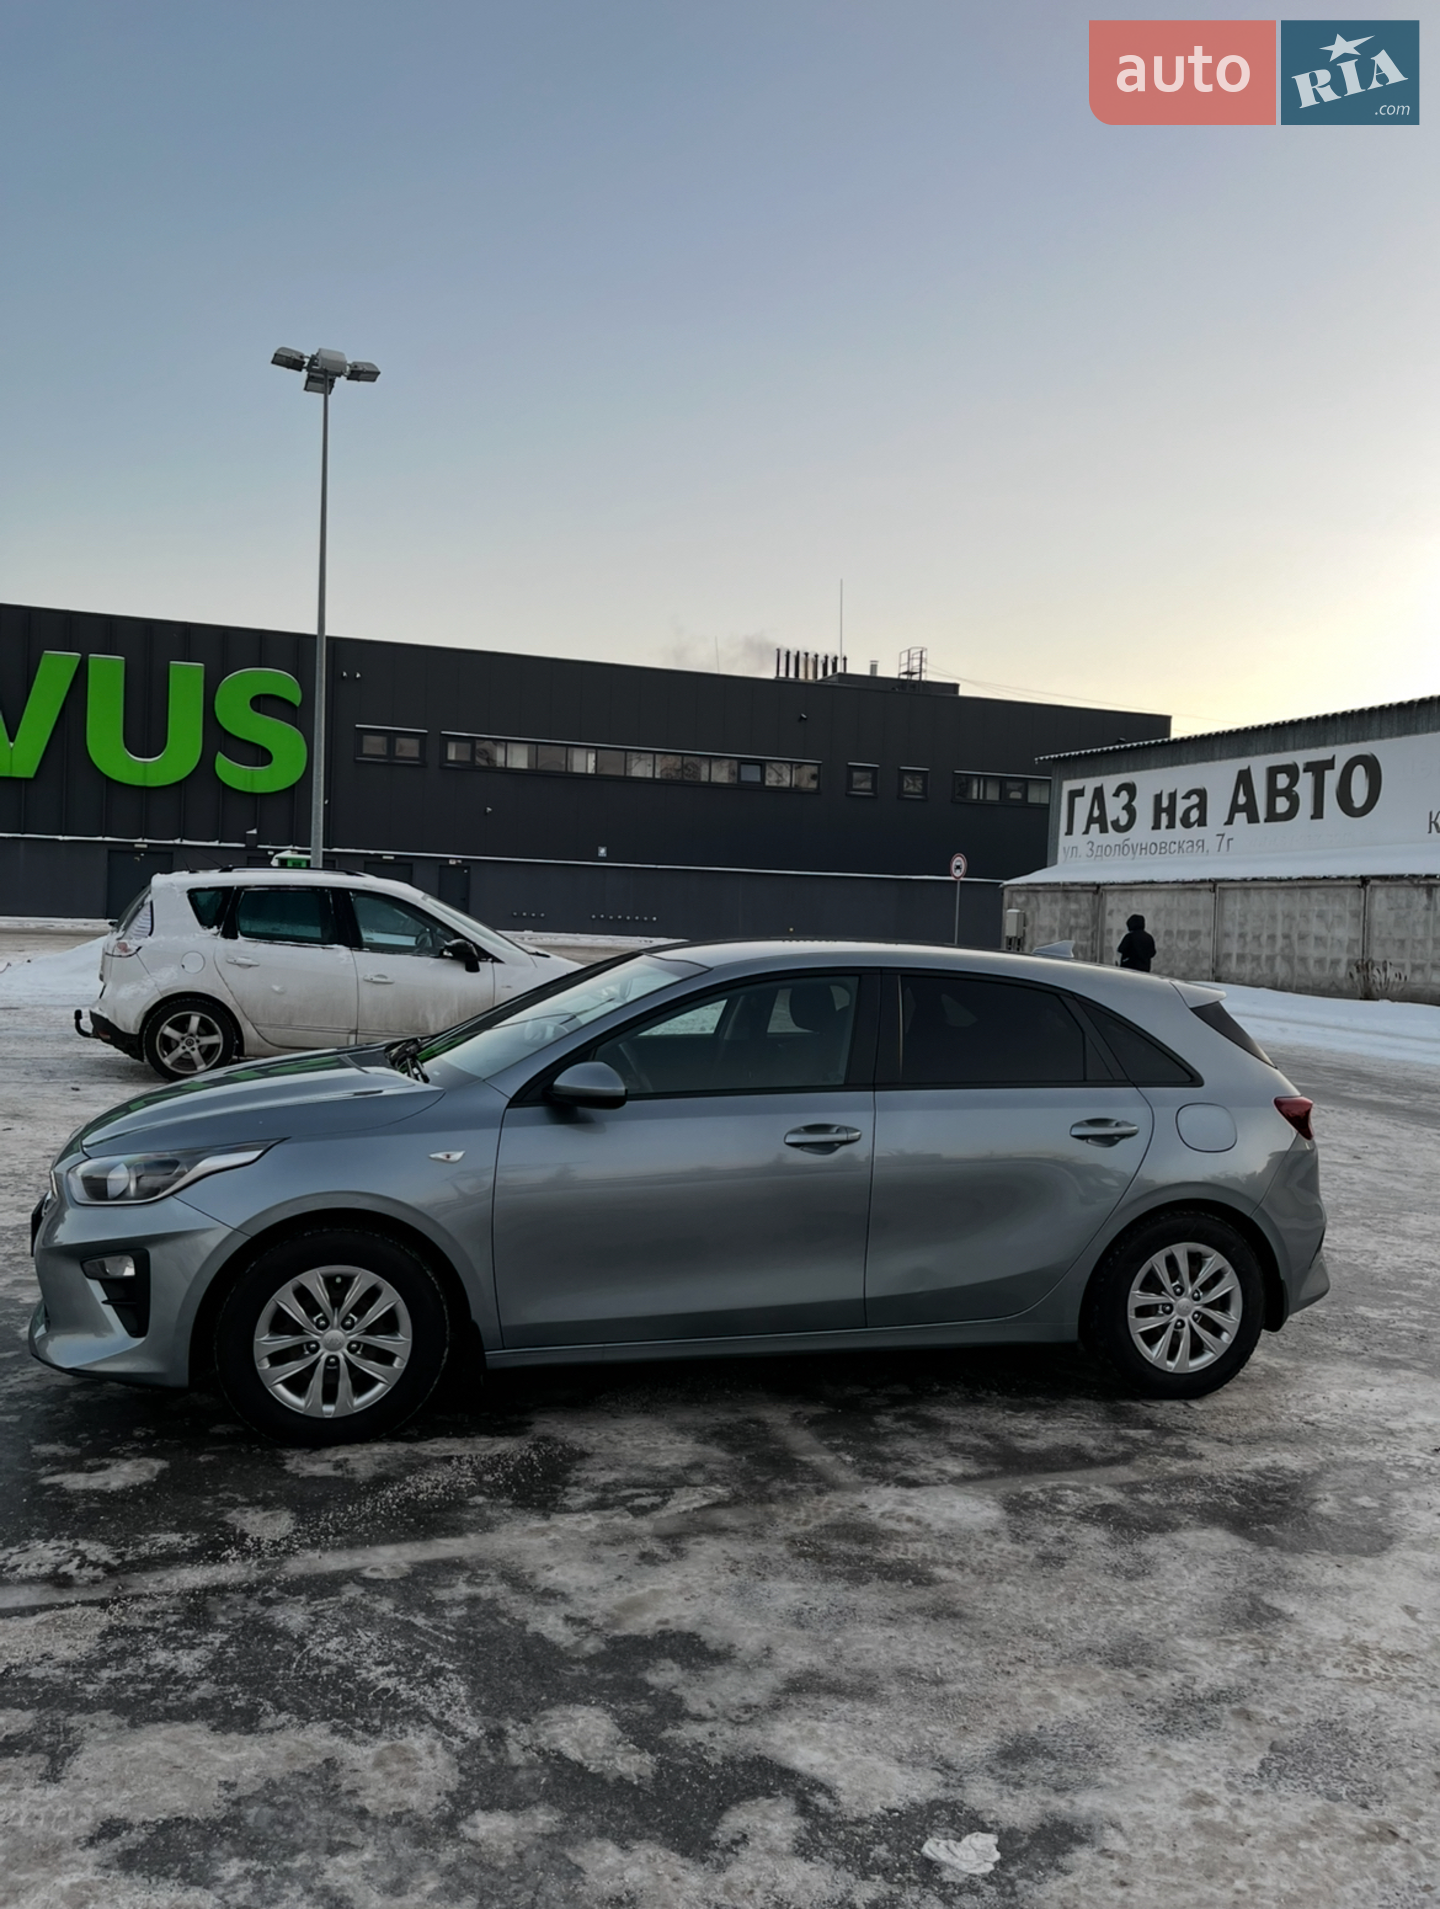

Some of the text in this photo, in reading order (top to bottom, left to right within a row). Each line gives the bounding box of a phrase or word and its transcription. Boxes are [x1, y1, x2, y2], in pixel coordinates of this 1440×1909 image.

[1064, 779, 1138, 836] ГАЗ
[1151, 785, 1209, 831] на
[1223, 751, 1383, 826] АВТО
[1062, 844, 1082, 862] ул.
[1086, 837, 1210, 861] Здолбуновская,
